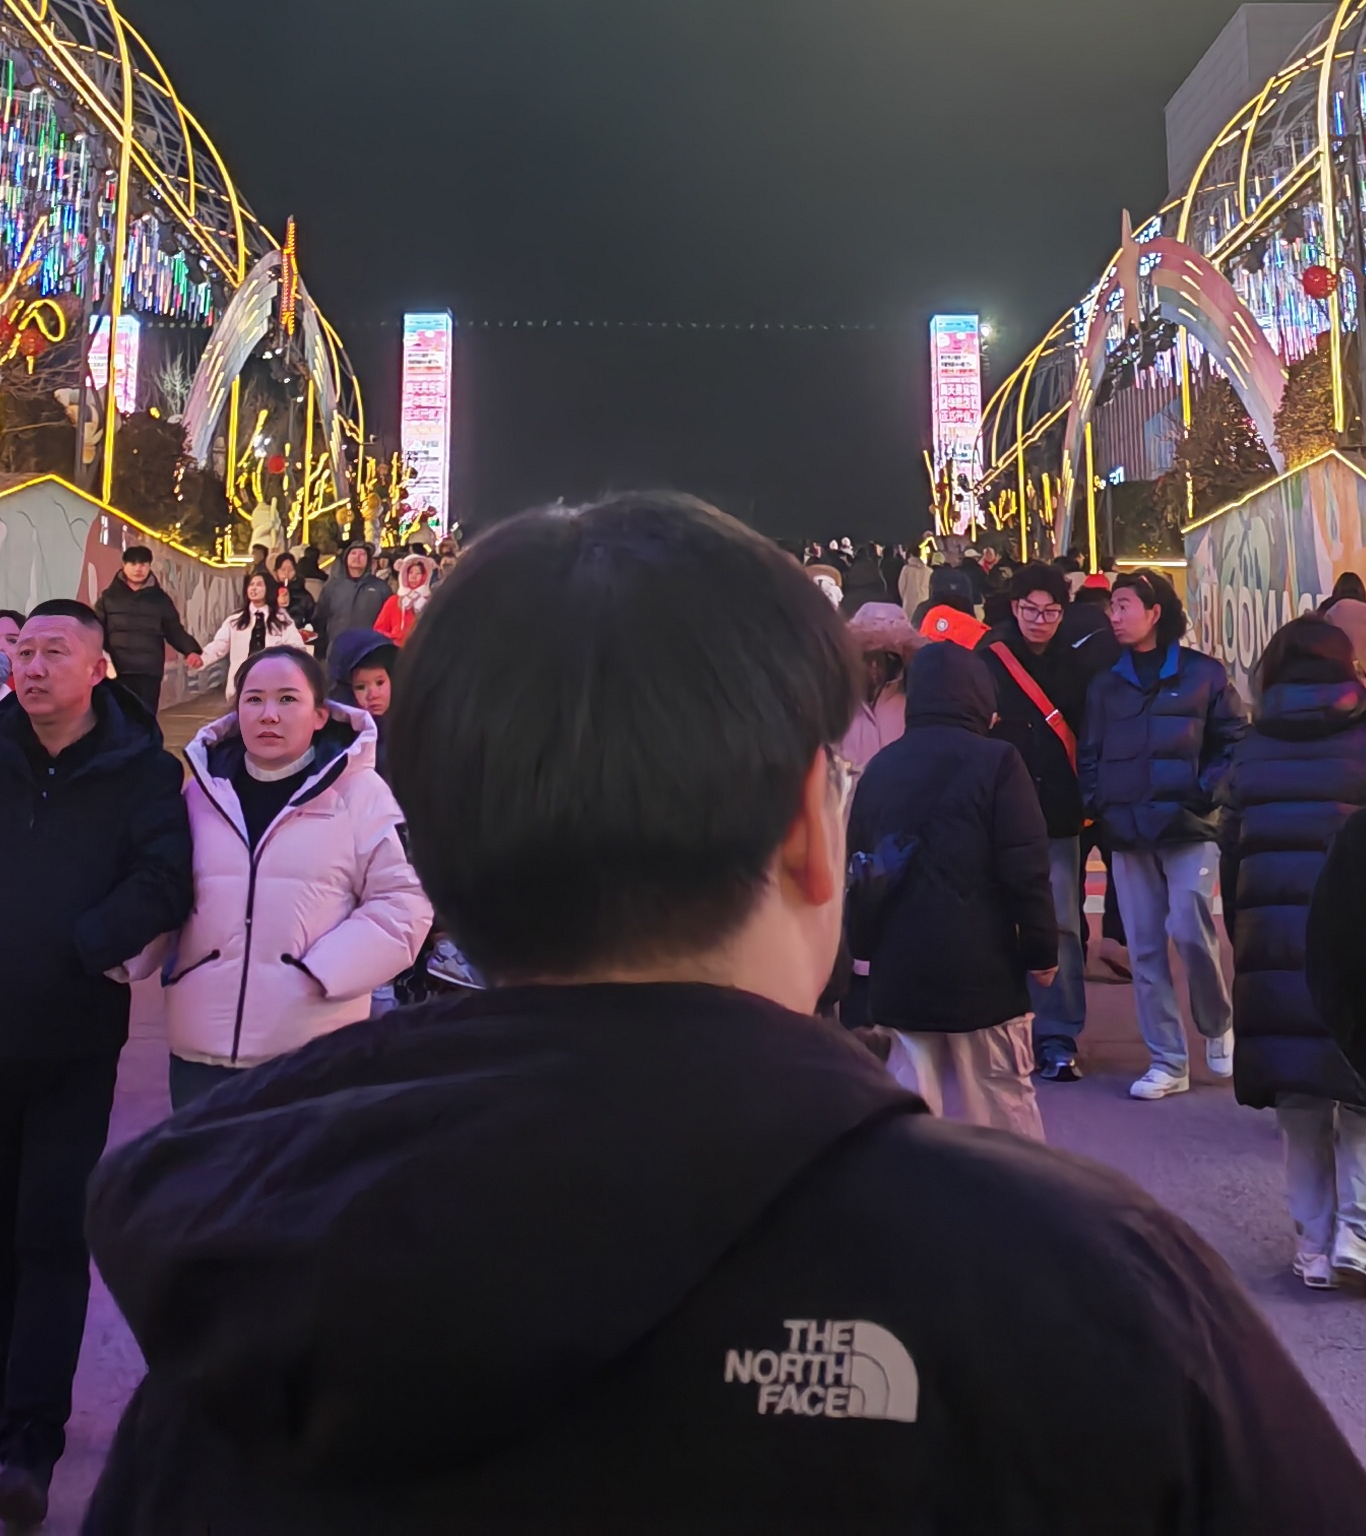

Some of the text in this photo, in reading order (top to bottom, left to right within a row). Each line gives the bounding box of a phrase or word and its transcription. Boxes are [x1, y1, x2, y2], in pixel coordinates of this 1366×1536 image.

[1200, 582, 1331, 668] BLOOM
[783, 1319, 855, 1353] THE
[724, 1349, 852, 1386] NORTH
[758, 1383, 850, 1418] FACE
